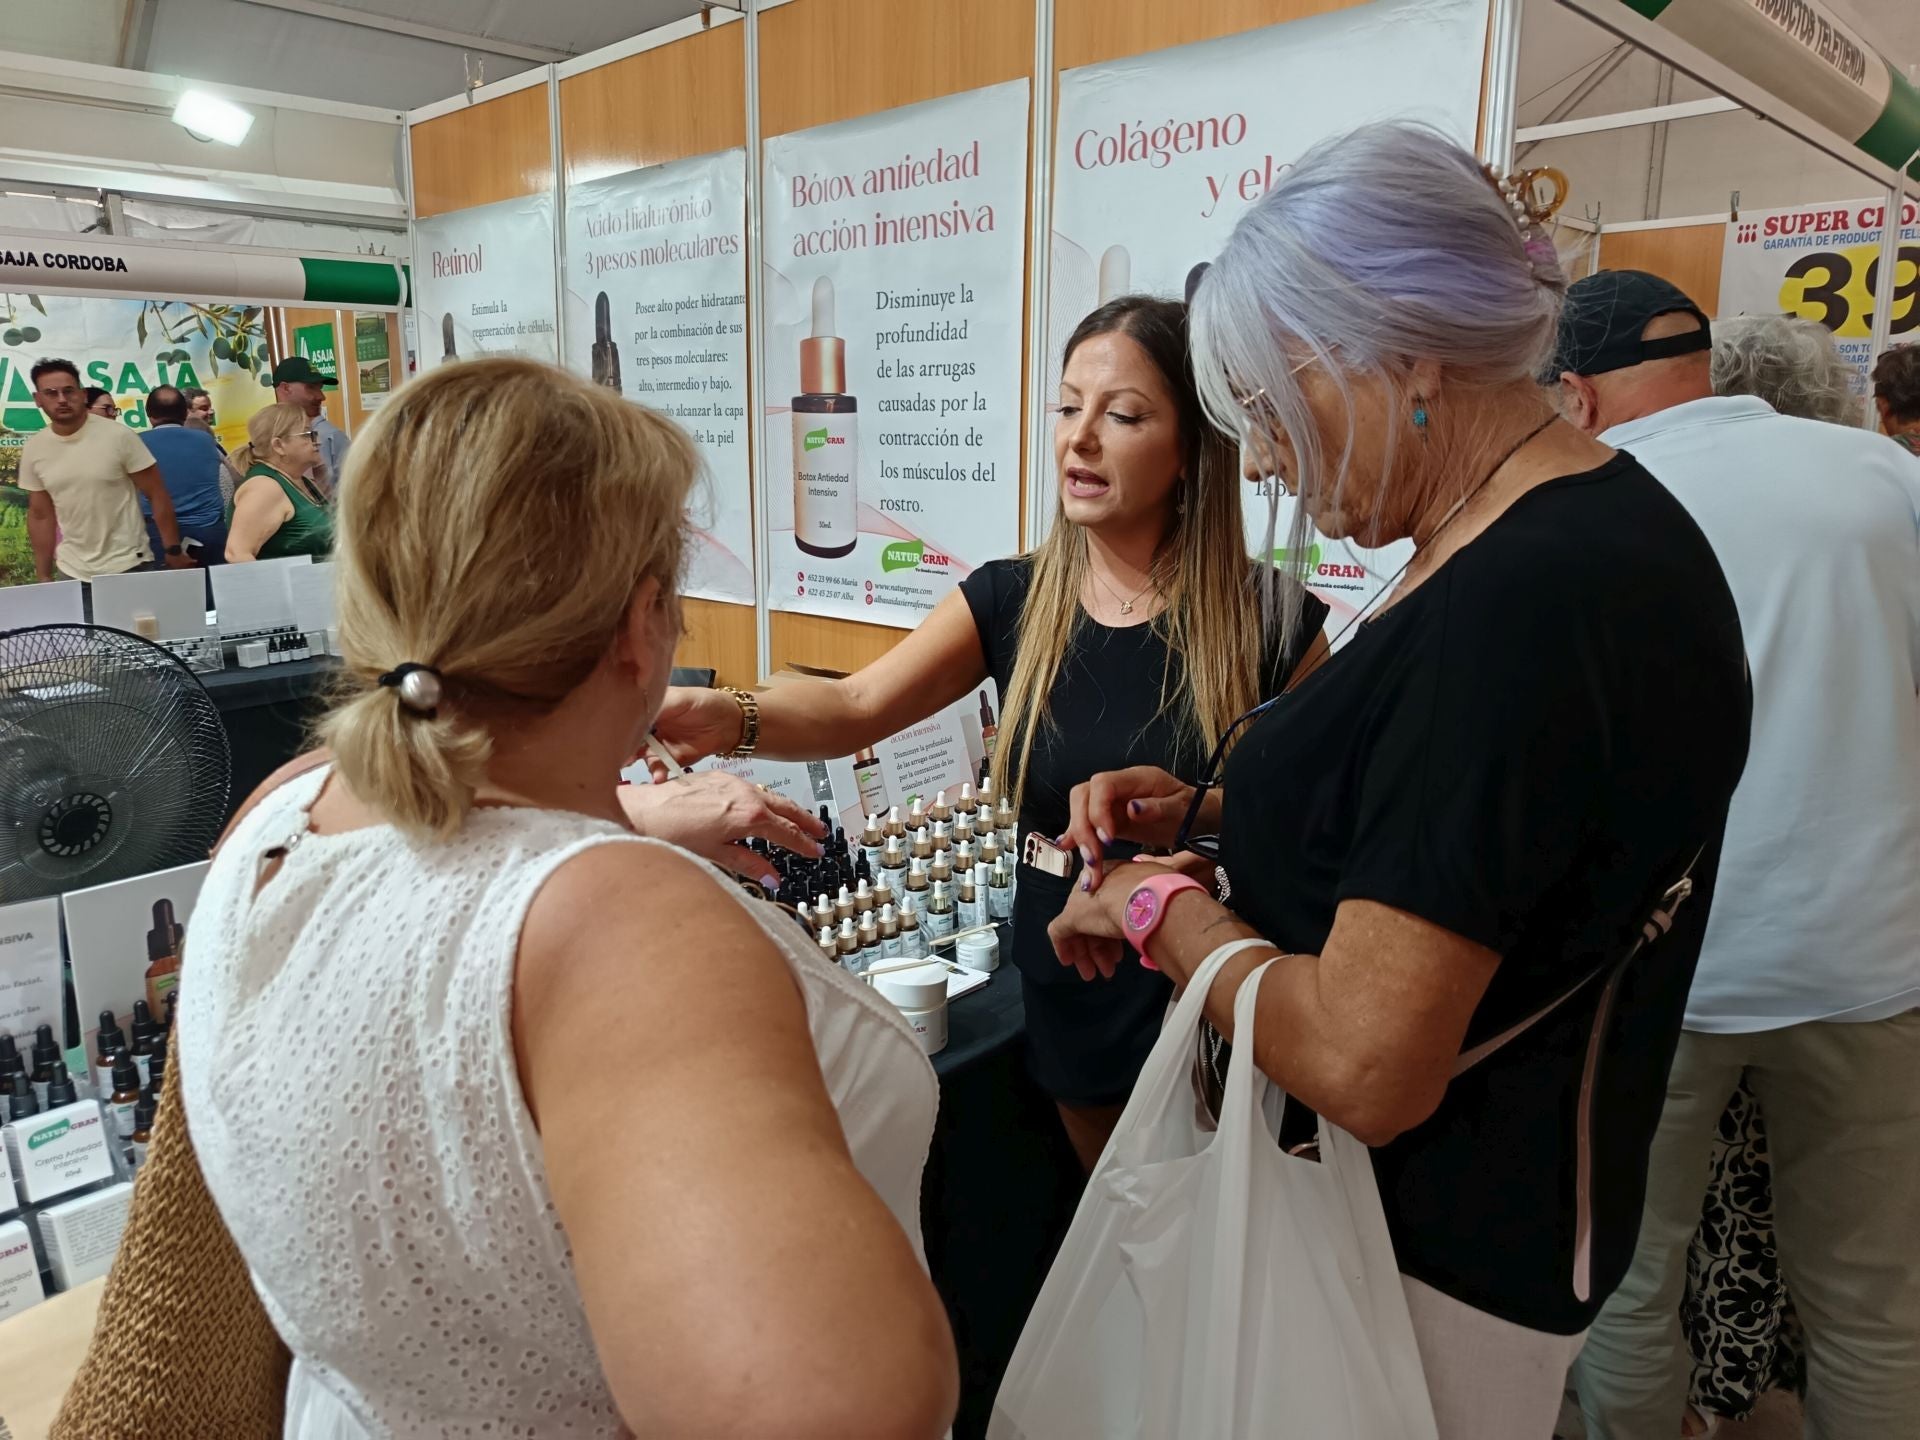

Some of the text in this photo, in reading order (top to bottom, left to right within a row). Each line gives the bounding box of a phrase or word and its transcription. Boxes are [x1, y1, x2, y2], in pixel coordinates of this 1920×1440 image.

[1755, 0, 1865, 86] ODUCTOS TELETIENDA
[1075, 112, 1247, 169] Colágeno
[792, 140, 980, 208] Bótox antiedad
[1201, 174, 1228, 218] y
[584, 196, 712, 239] Ácido Hialurónico
[1763, 210, 1849, 236] SUPER
[793, 200, 995, 257] acción intensiva
[1763, 234, 1812, 249] GARANTÍA
[1816, 235, 1830, 246] DE
[1832, 231, 1882, 243] PRODUCT
[43, 252, 128, 272] CORDOBA
[432, 243, 482, 279] Retinol
[585, 234, 739, 279] 3 pesos moleculares
[472, 299, 508, 316] Estimula la
[635, 302, 655, 314] Posee
[657, 299, 673, 313] alto
[675, 296, 699, 314] poder
[875, 283, 974, 311] Disminuye la
[472, 318, 555, 341] regeneración de células,
[635, 320, 743, 344] por la combinación de sus
[876, 319, 968, 349] profundidad
[312, 348, 334, 364] ASAJA
[636, 348, 729, 369] tres pesos moleculares:
[876, 358, 976, 382] de las arrugas
[638, 376, 732, 393] alto, intermedio y bajo.
[676, 404, 711, 417] alcanzar
[714, 403, 722, 416] la
[725, 406, 744, 420] capa
[878, 391, 987, 417] causadas por la
[693, 430, 734, 447] de la piel
[879, 426, 983, 447] contracción de
[798, 471, 849, 483] Botox Antiedad
[880, 460, 996, 482] los músculos del
[880, 498, 924, 513] rostro.
[887, 550, 949, 566] NATUR GRAN
[1317, 563, 1365, 578] GRAN
[875, 583, 933, 596] www.naturgran.com
[913, 723, 941, 738] intensiva
[894, 747, 919, 759] Disminuye
[925, 736, 953, 752] profundidad
[914, 763, 941, 776] contracción
[71, 1117, 98, 1130] GRAN
[35, 1141, 103, 1167] Crema Antiedad
